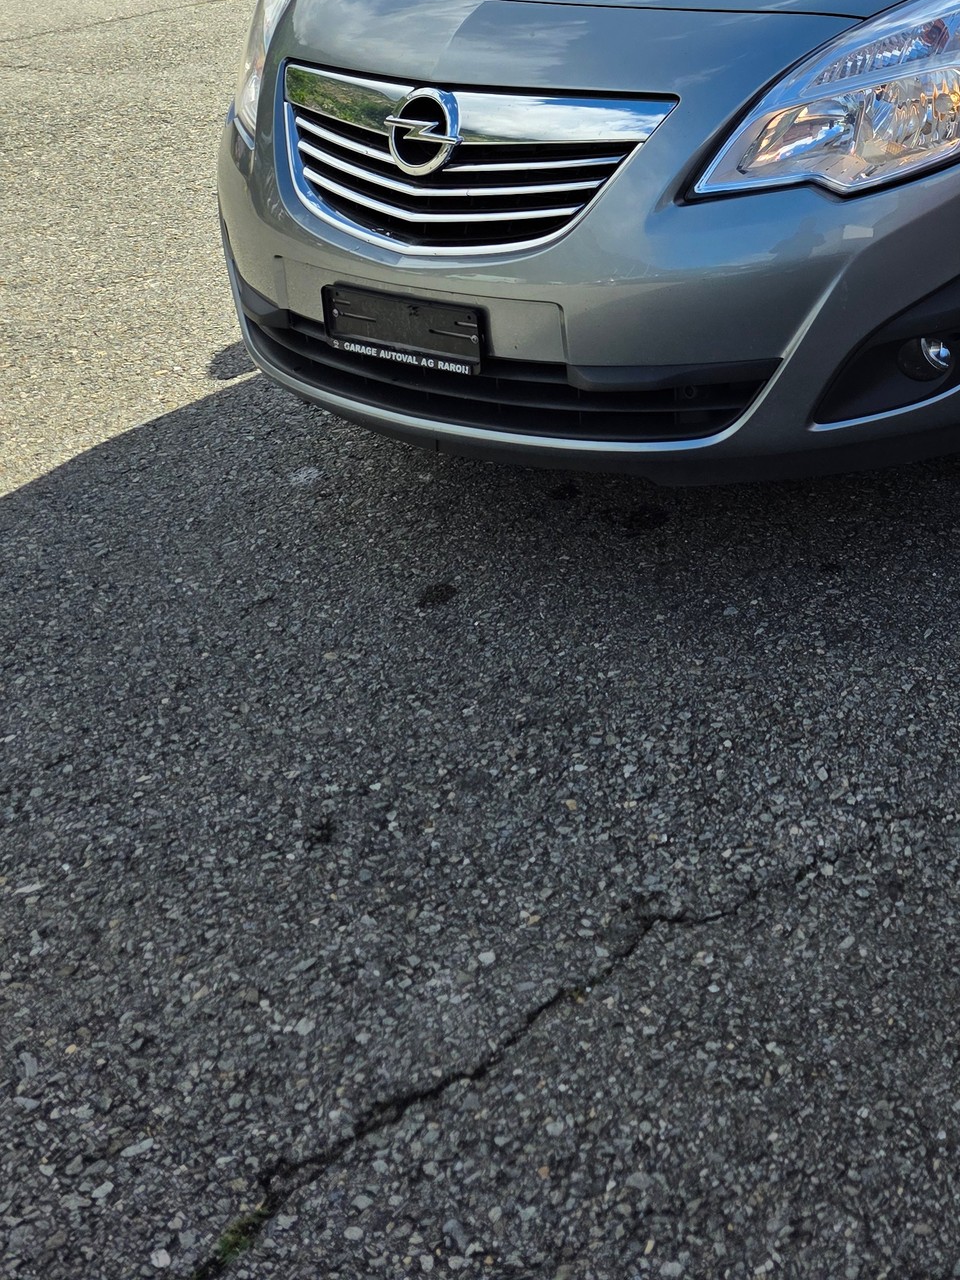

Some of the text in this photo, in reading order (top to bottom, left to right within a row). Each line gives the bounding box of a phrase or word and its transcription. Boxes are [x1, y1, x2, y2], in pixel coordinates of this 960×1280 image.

[344, 342, 377, 357] GARAGE
[379, 350, 418, 365] AUTOVAL
[420, 357, 434, 368] AG
